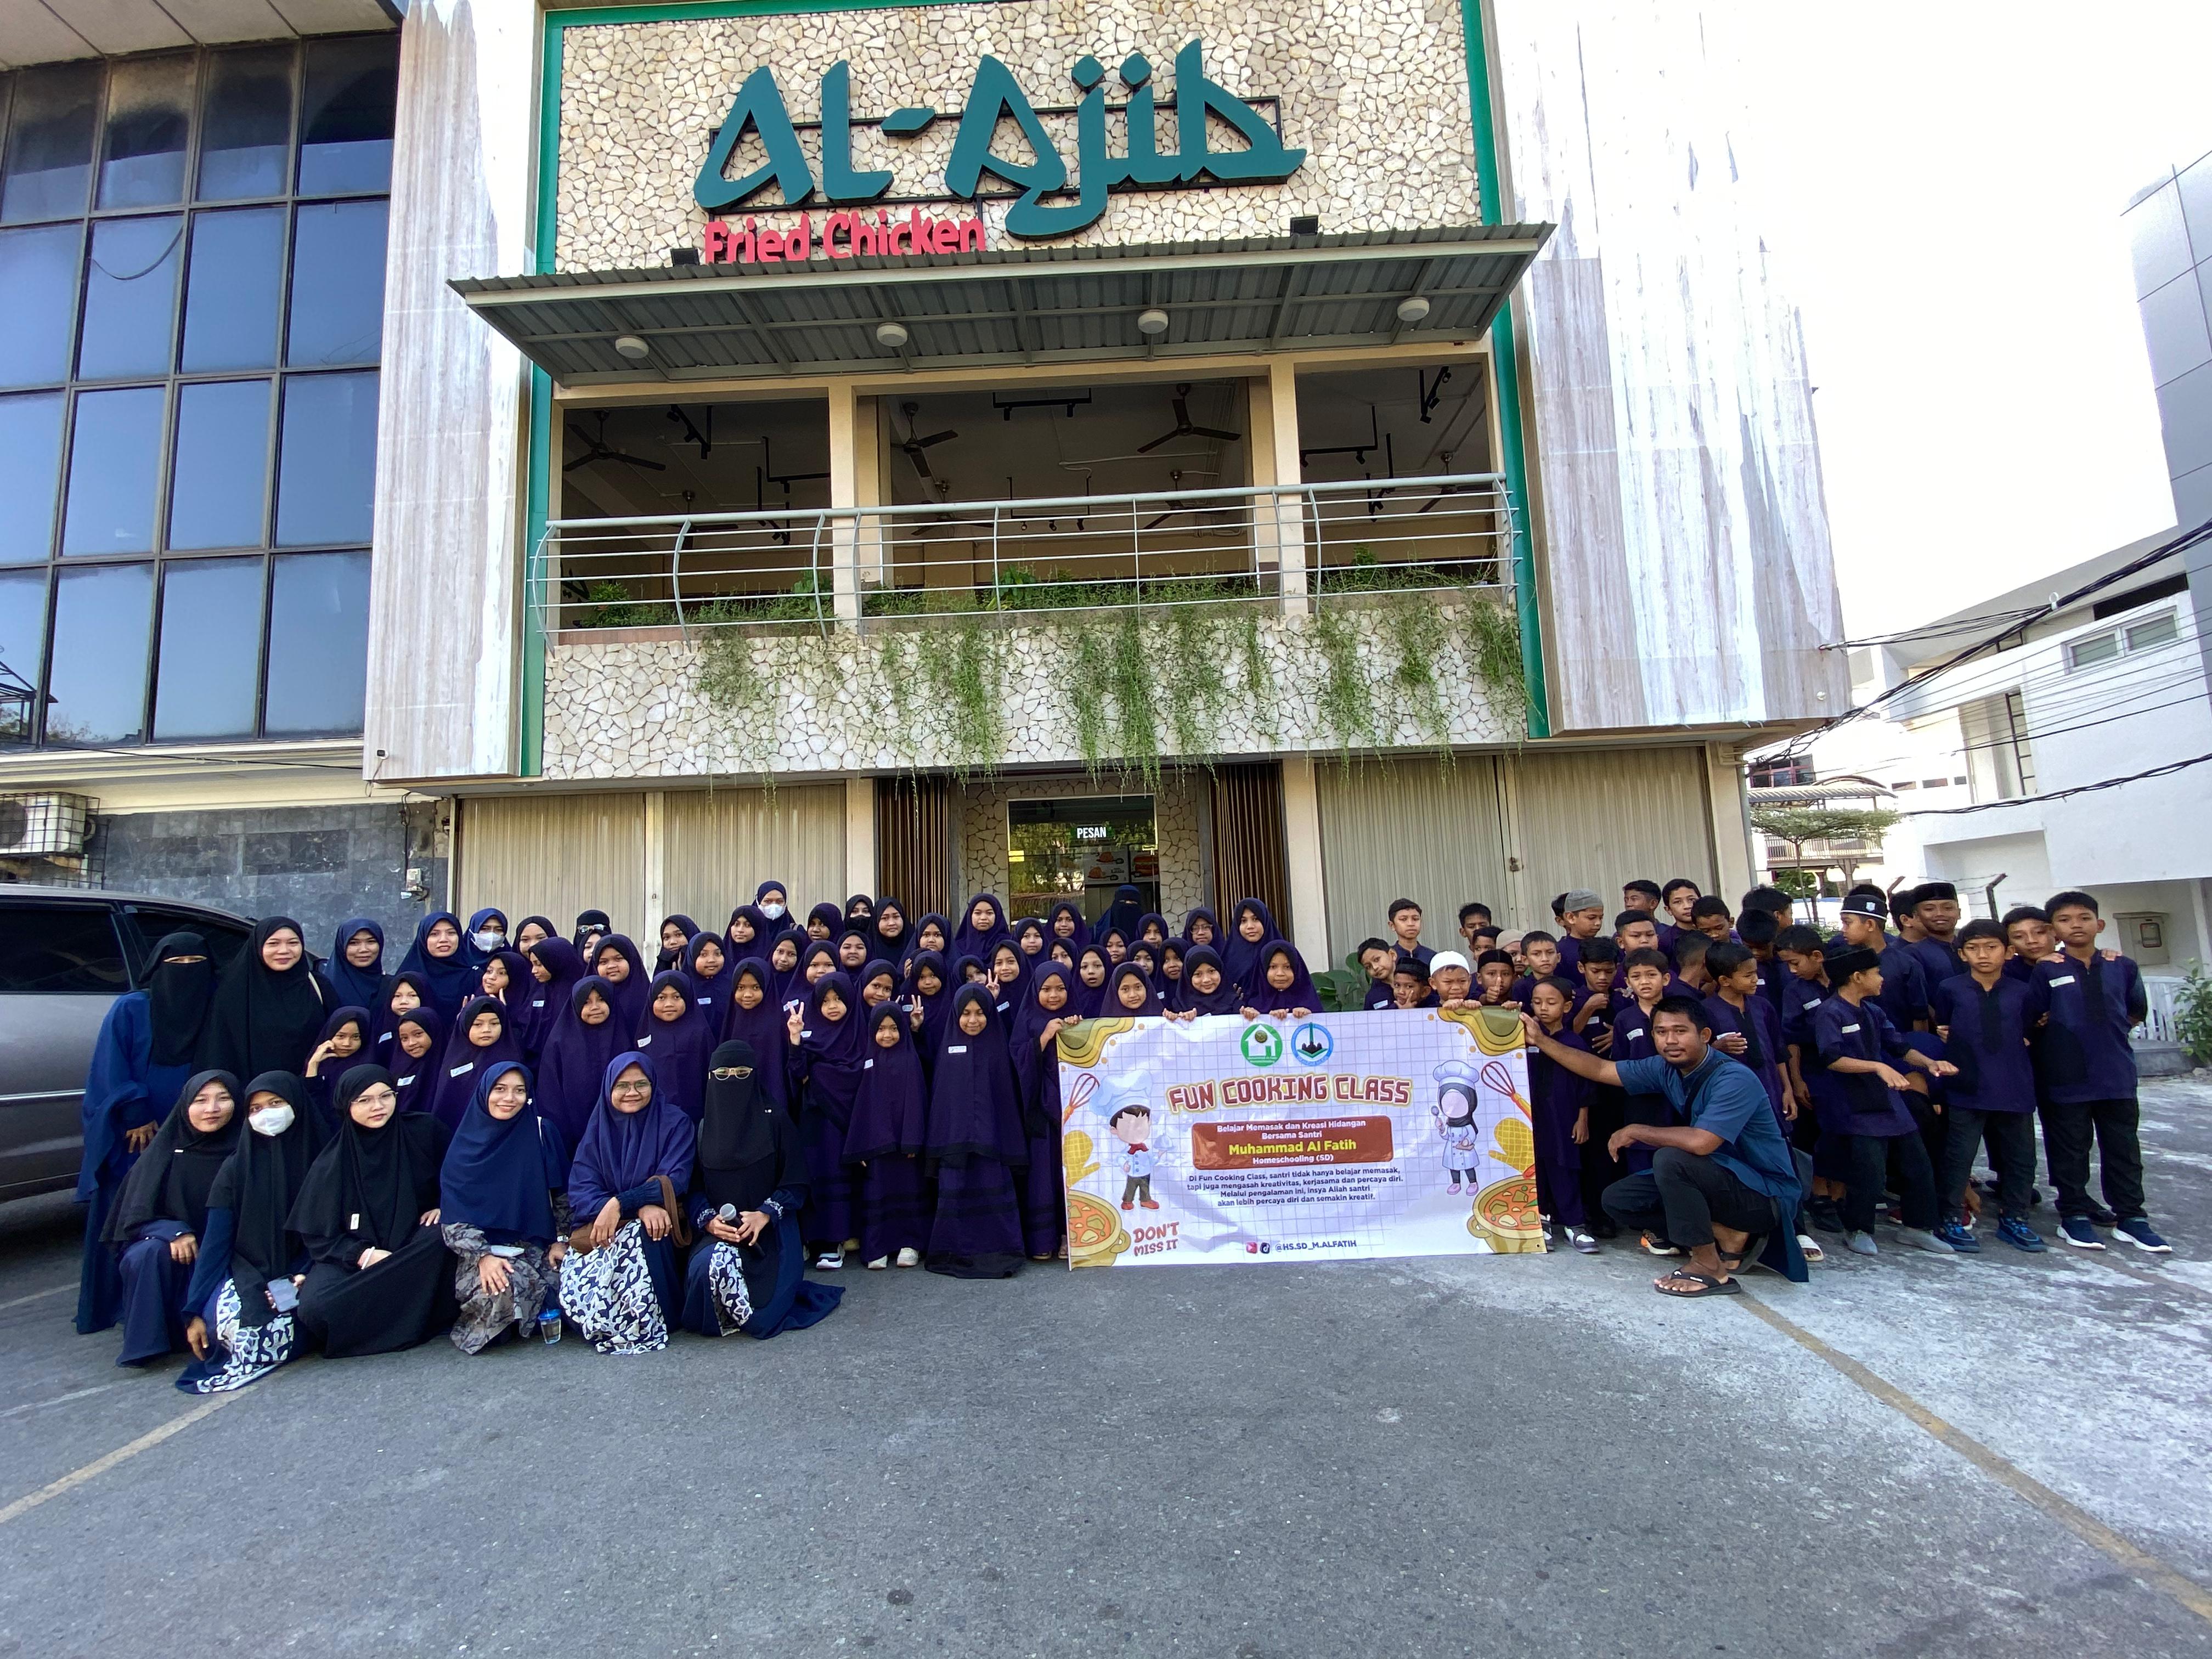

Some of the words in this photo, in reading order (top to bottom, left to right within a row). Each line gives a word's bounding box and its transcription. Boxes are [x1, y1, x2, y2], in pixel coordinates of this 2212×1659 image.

[704, 213, 810, 264] Fried
[823, 206, 986, 258] Chicken
[1077, 827, 1107, 838] PESAN
[1169, 1081, 1214, 1113] FUN
[1222, 1075, 1328, 1105] COOKING
[1334, 1075, 1410, 1104] CLASS
[1217, 1124, 1245, 1132] Belajar
[1328, 1120, 1366, 1128] Hidangan
[1229, 1141, 1304, 1155] Muhammad
[1307, 1141, 1321, 1152] Al
[1324, 1139, 1357, 1151] Fatih
[1252, 1155, 1314, 1164] Homeschooling
[1316, 1154, 1334, 1162] (SD)
[1214, 1173, 1245, 1182] Cooking
[1336, 1168, 1361, 1176] belajar
[1303, 1178, 1340, 1186] kerjasama
[1249, 1189, 1293, 1198] pengalaman
[1256, 1198, 1285, 1206] percaya
[1317, 1194, 1347, 1202] semakin
[1133, 1221, 1180, 1243] DON'T
[1133, 1241, 1164, 1256] MISS
[1166, 1238, 1178, 1250] IT
[1275, 1240, 1357, 1252] @HS.SD_M.ALFATIH
